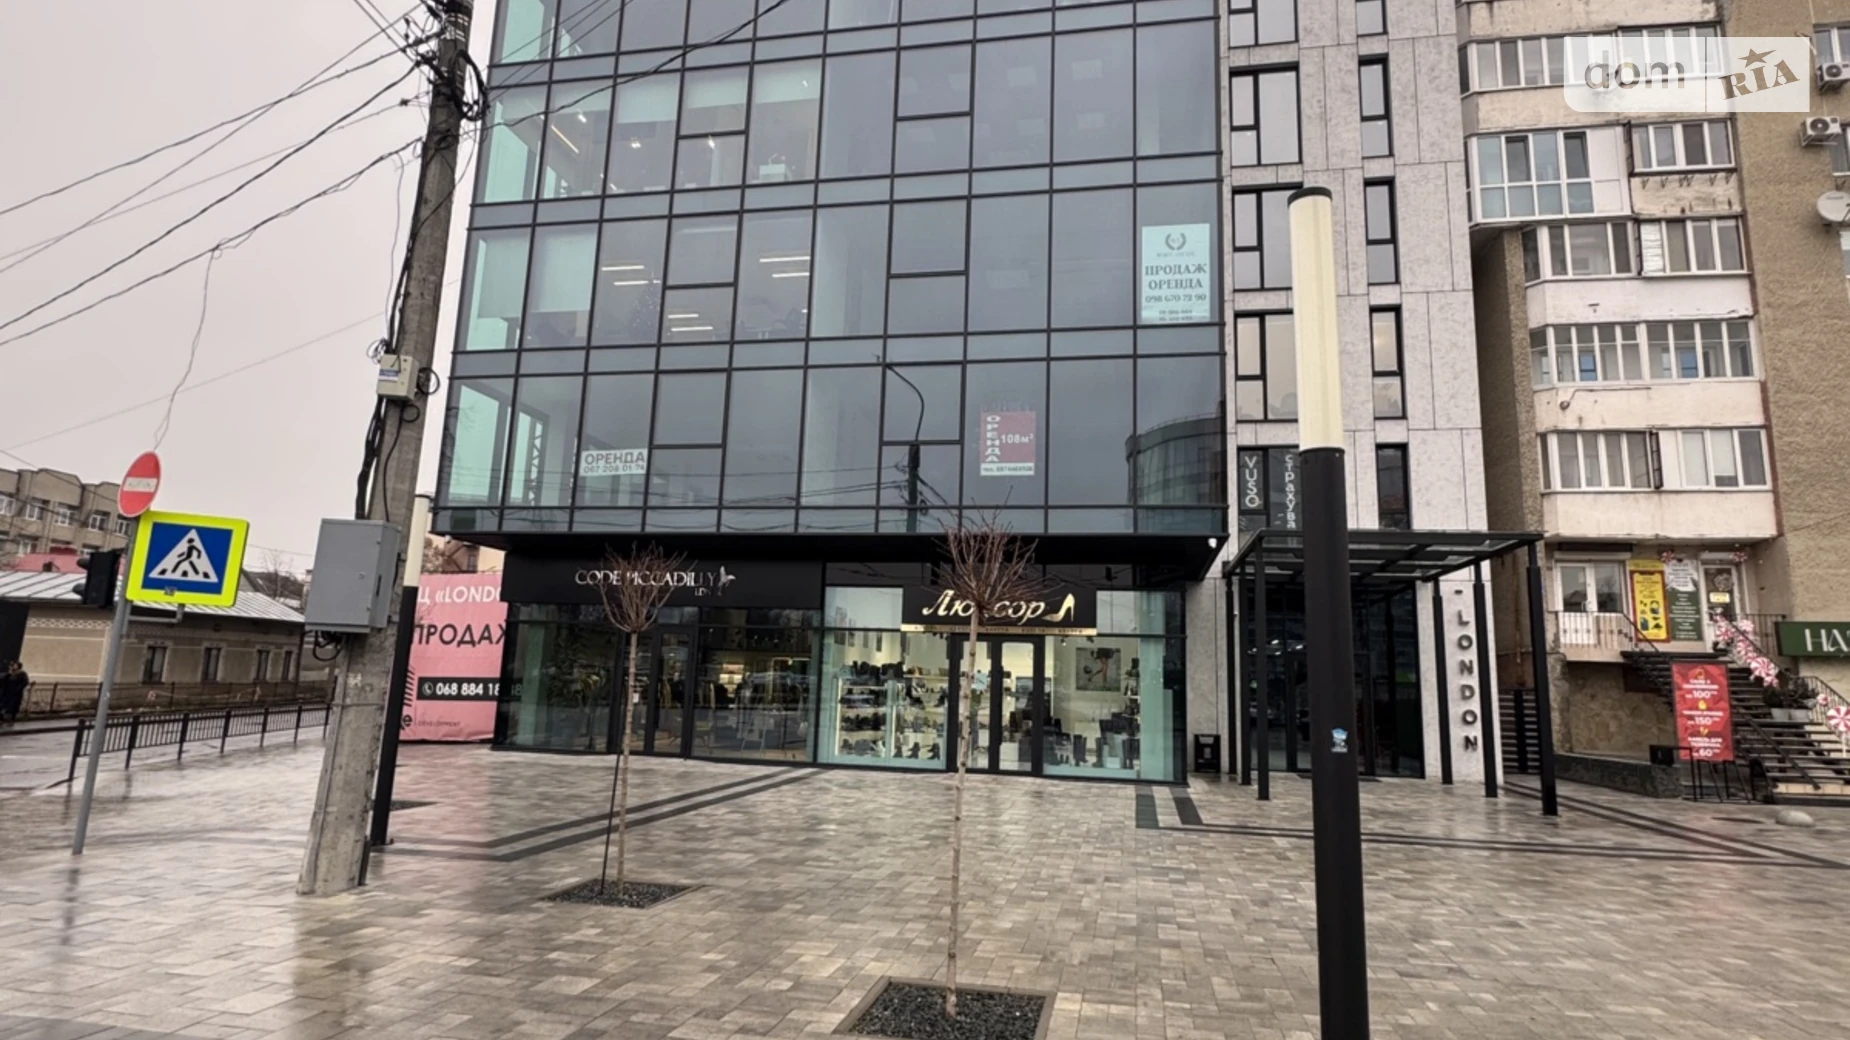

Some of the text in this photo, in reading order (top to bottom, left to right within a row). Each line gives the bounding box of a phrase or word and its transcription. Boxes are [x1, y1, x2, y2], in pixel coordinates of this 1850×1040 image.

[1144, 263, 1208, 275] ПРОДАЖ
[1148, 278, 1204, 290] ОРЕНДА
[585, 452, 645, 464] ОРЕНДА
[1284, 454, 1297, 528] страхува
[575, 570, 622, 586] CODE
[921, 589, 1046, 625] Люсор
[1457, 609, 1479, 752] LONDON
[436, 683, 458, 696] 068
[461, 682, 484, 696] 884
[1692, 690, 1711, 699] 100
[1694, 716, 1712, 726] 150
[1699, 748, 1713, 757] 60
